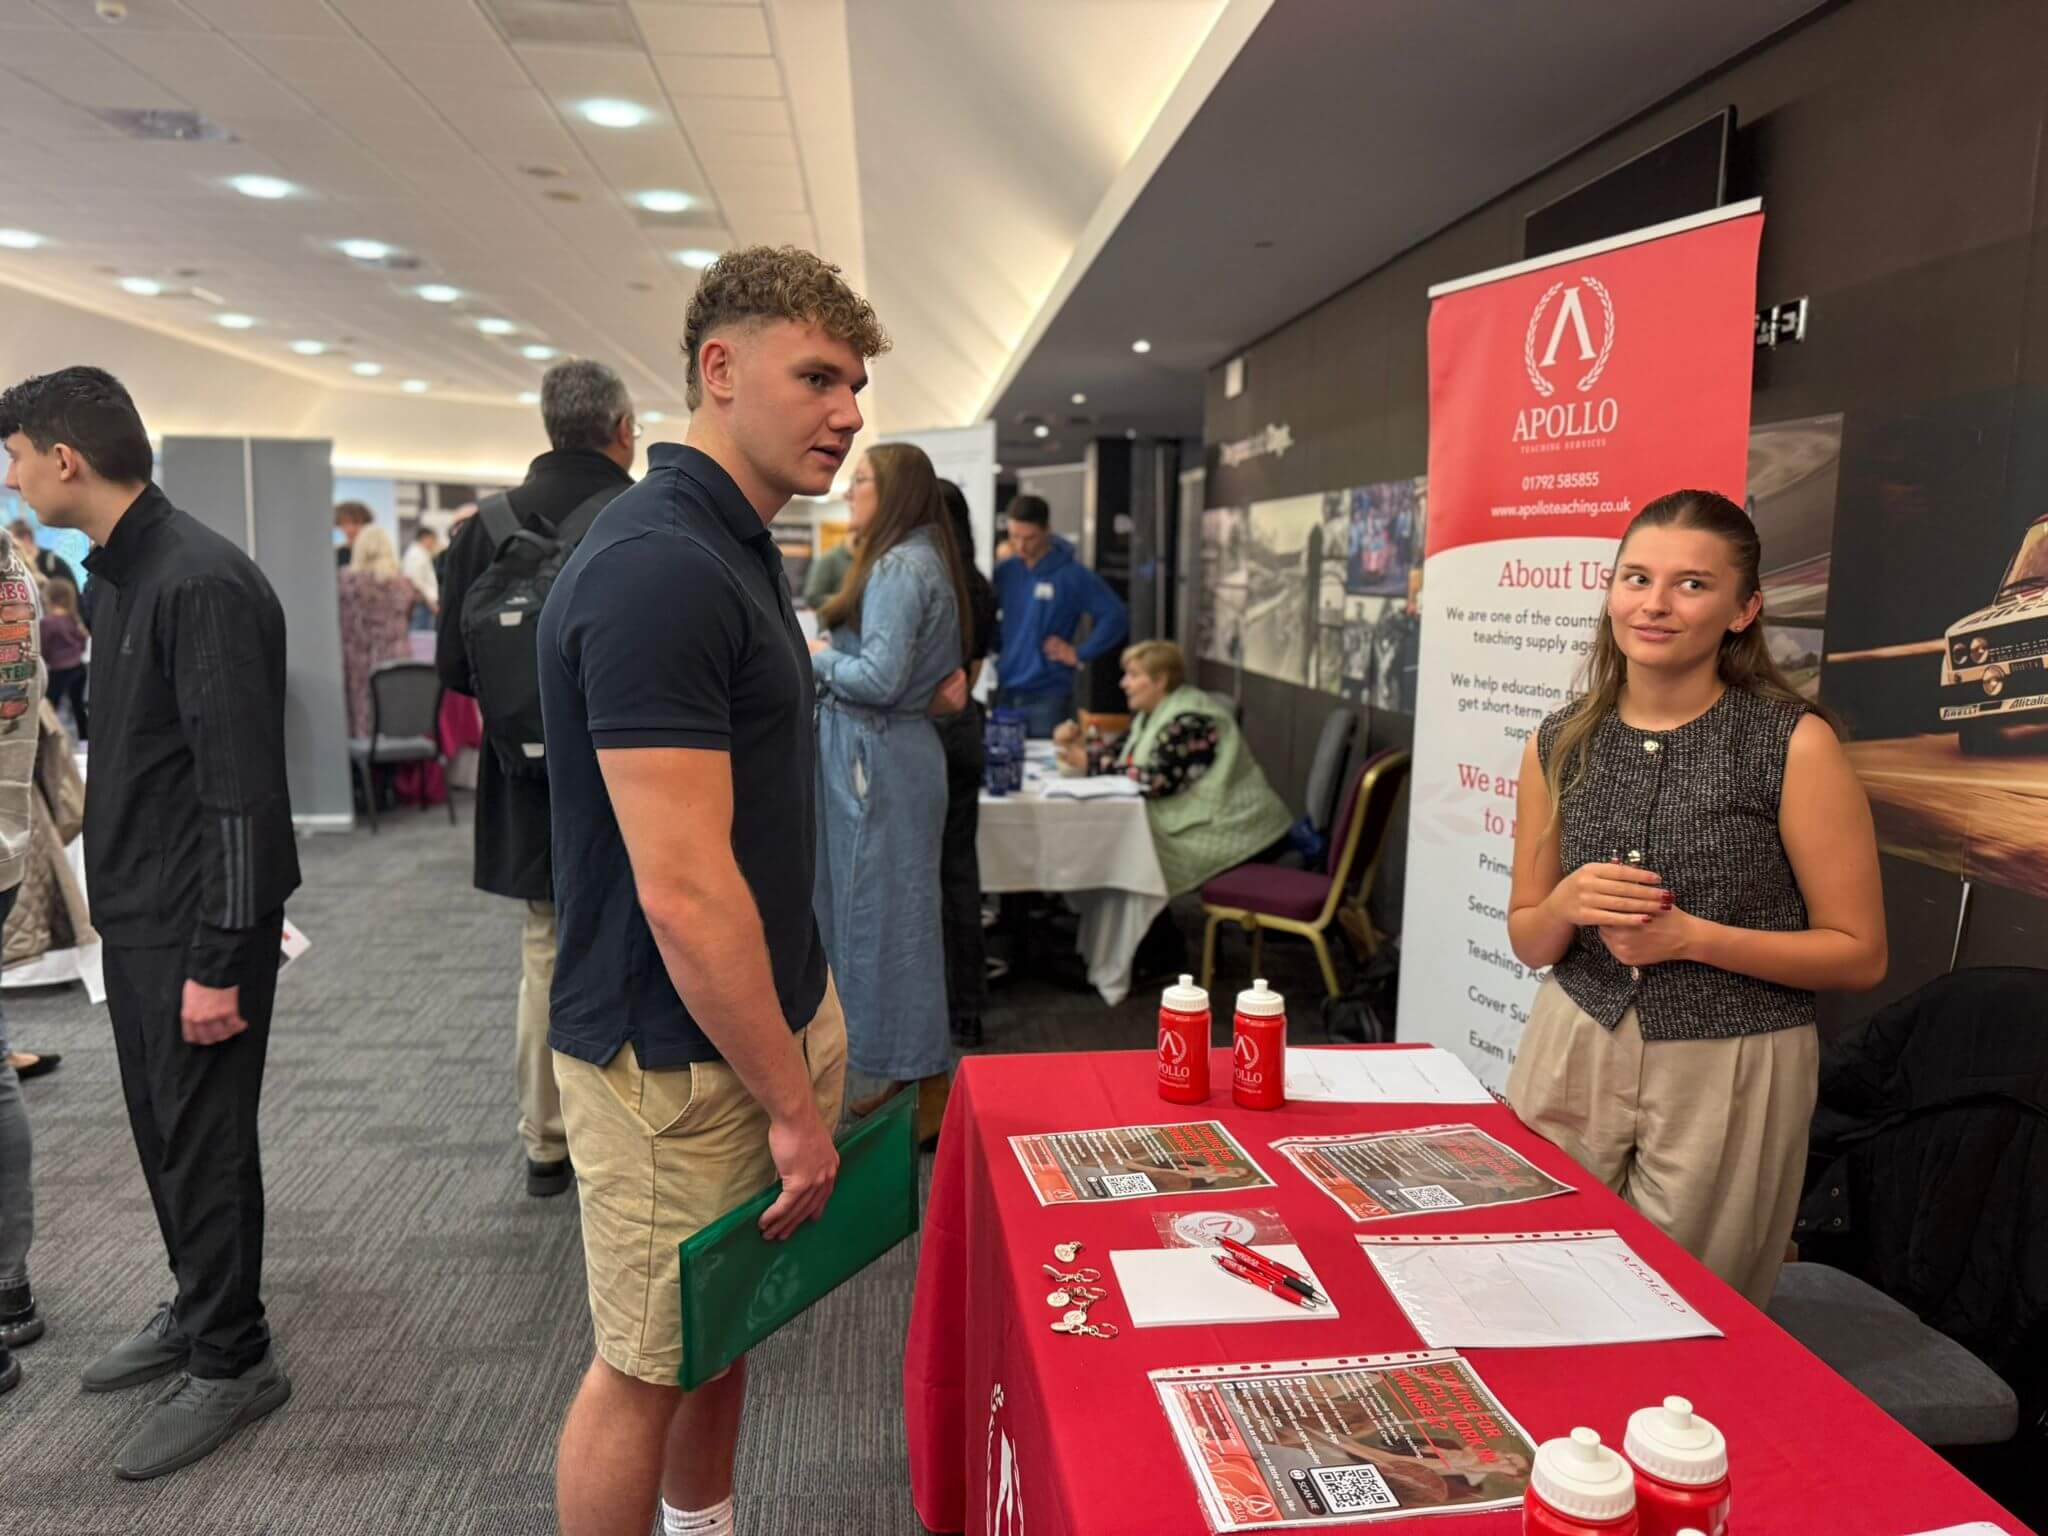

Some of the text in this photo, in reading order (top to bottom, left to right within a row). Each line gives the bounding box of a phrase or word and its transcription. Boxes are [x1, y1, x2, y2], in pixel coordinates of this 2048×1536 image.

[1512, 398, 1619, 442] APOLLO
[1522, 471, 1599, 491] 01792 585855
[1491, 496, 1631, 519] www.apolloteaching.co.uk
[1498, 559, 1615, 591] About Us
[1447, 607, 1465, 620] We
[1468, 611, 1487, 622] are
[1490, 612, 1512, 624] one
[1515, 609, 1529, 624] of
[1531, 610, 1551, 626] the
[1473, 631, 1523, 650] teaching
[1526, 634, 1568, 654] supply
[1451, 672, 1471, 688] We
[1474, 674, 1498, 694] help
[1502, 679, 1561, 699] education
[1458, 697, 1543, 718] get short-term
[1458, 763, 1490, 792] We
[1484, 808, 1505, 835] to
[1467, 938, 1524, 980] Teaching
[1468, 985, 1530, 1025] Cover Su
[1469, 1030, 1504, 1060] Exam
[1616, 1252, 1687, 1314] APOLLO
[1389, 1369, 1449, 1429] SWANSEA?
[1411, 1367, 1456, 1407] SUPPLY
[1448, 1410, 1486, 1446] WORK
[1431, 1365, 1503, 1437] LOOKING FOR
[1297, 1481, 1313, 1498] SCAN
